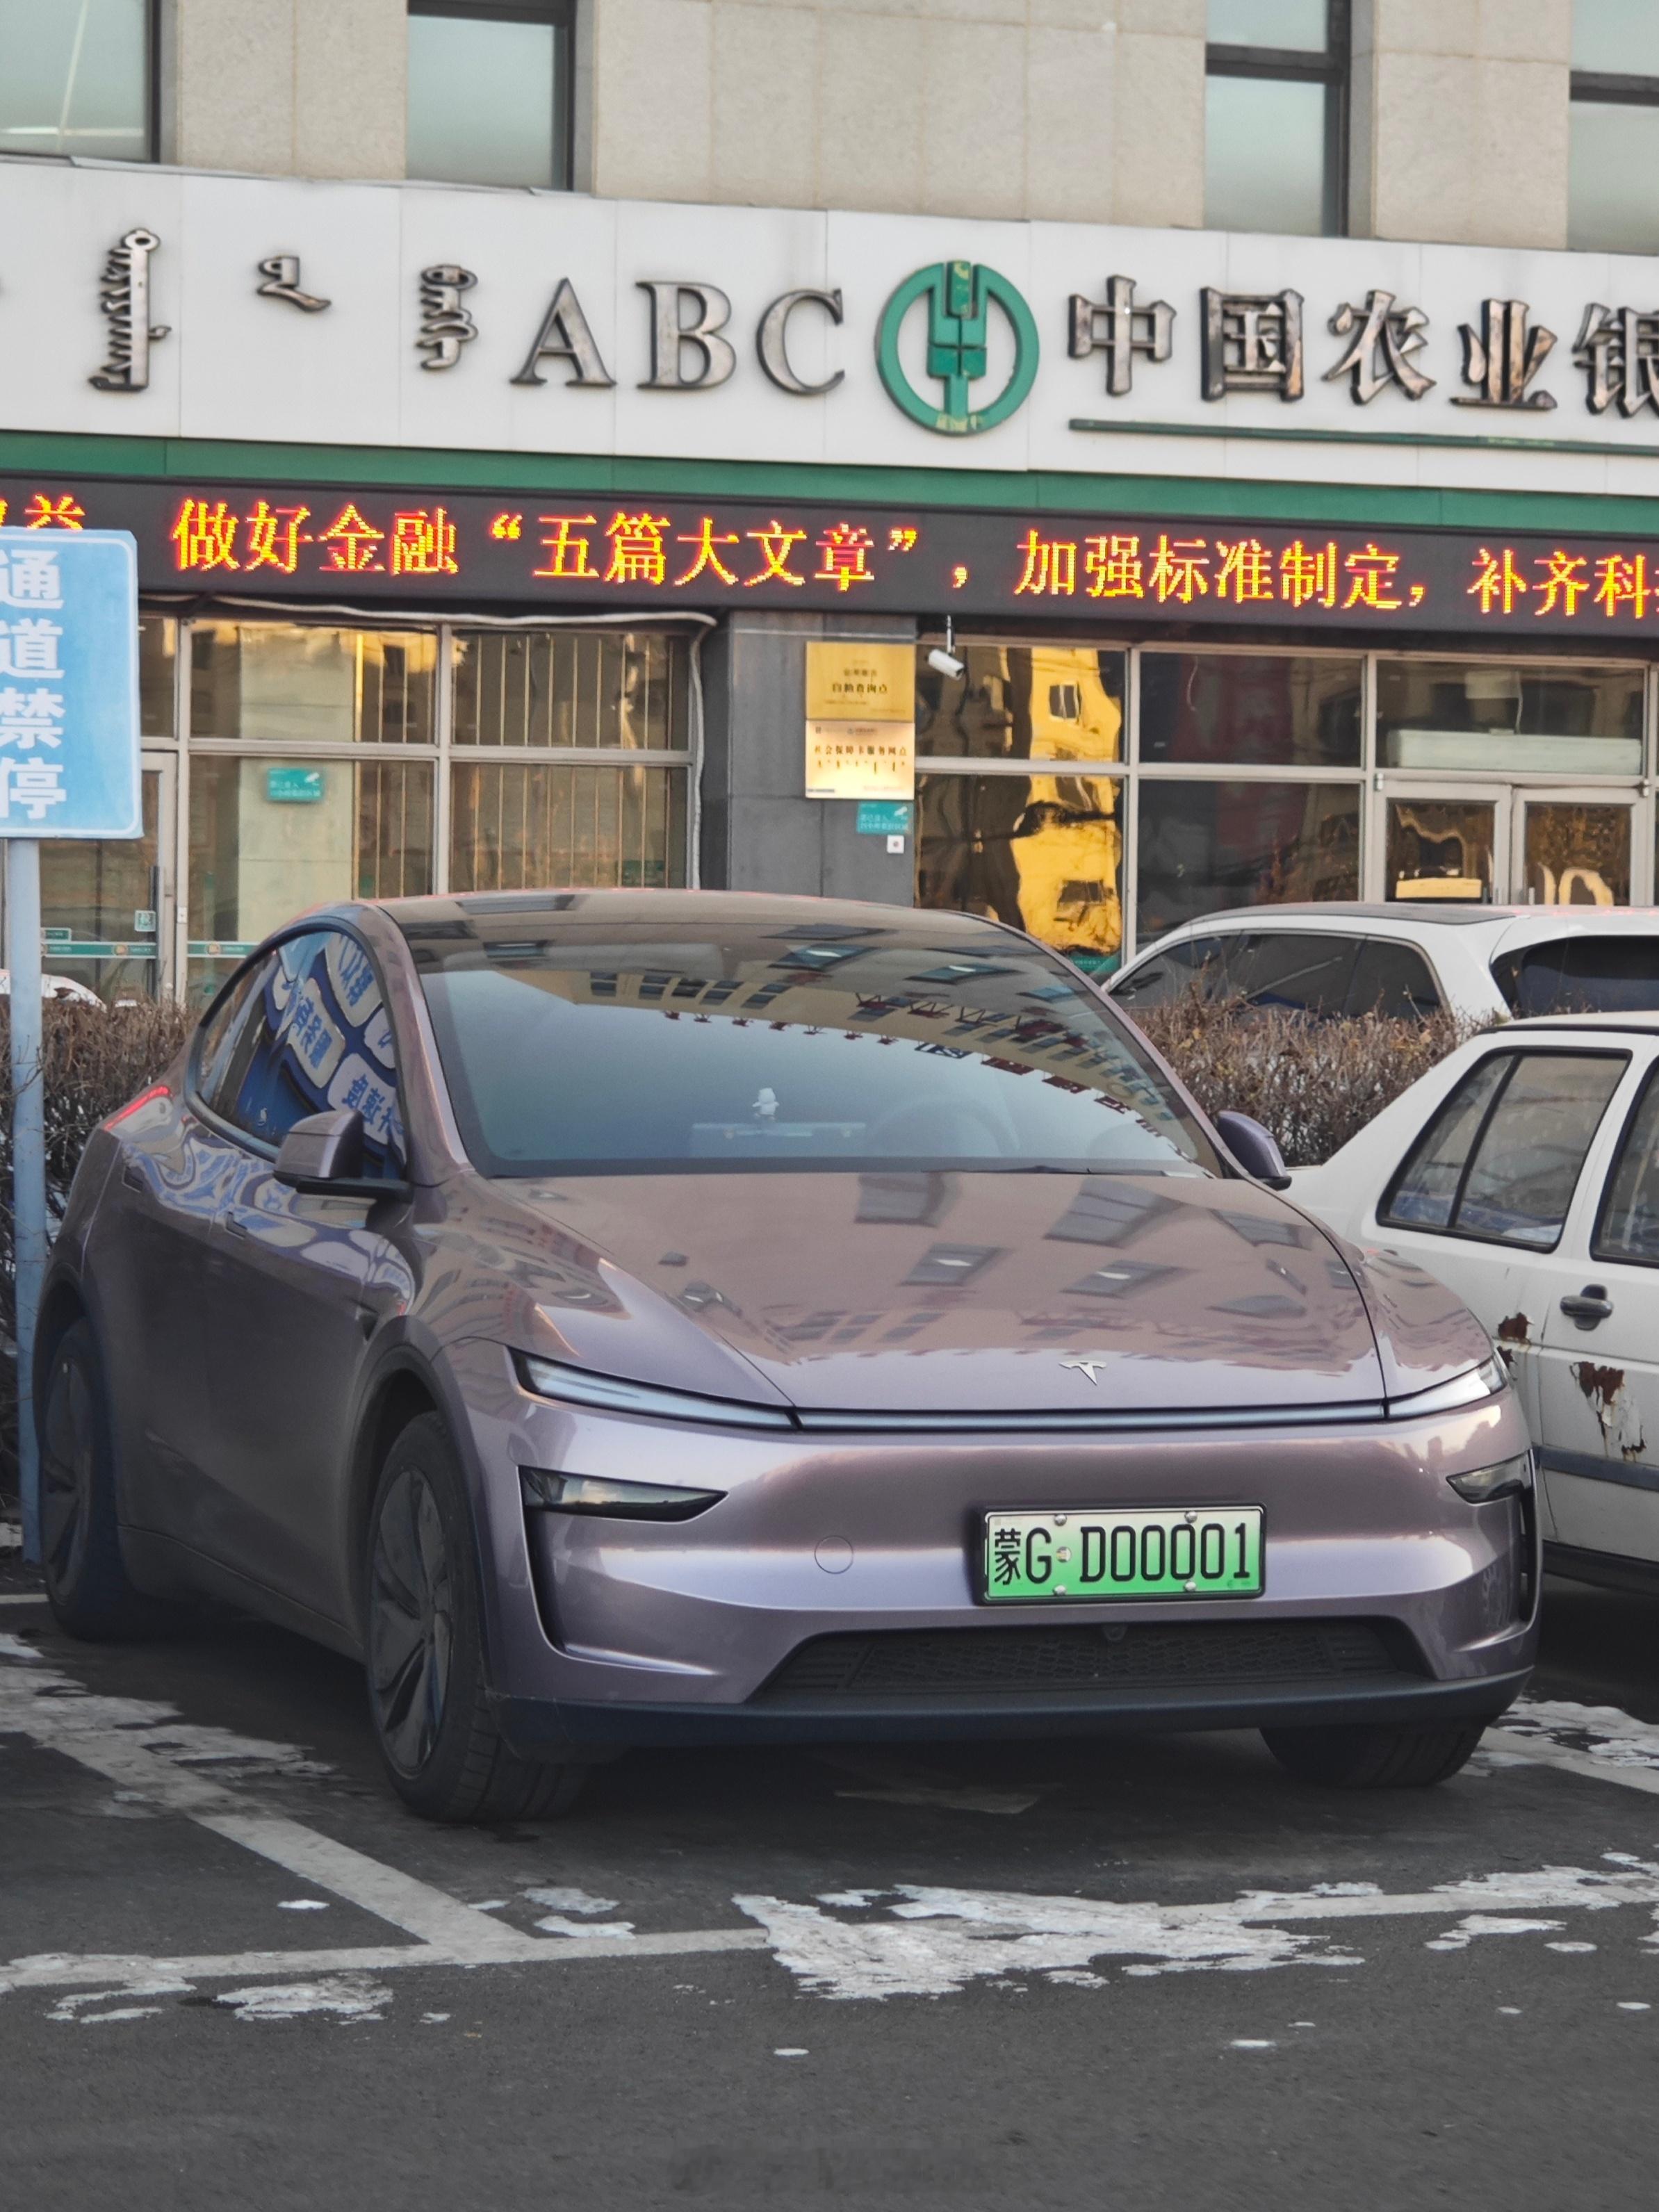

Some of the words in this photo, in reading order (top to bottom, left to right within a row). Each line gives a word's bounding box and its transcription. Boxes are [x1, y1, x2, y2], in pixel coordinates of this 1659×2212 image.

[509, 277, 845, 395] ABC
[1068, 274, 1659, 418] 中国农业银
[0, 548, 67, 819] 通道禁停
[1079, 1523, 1250, 1582] D00001
